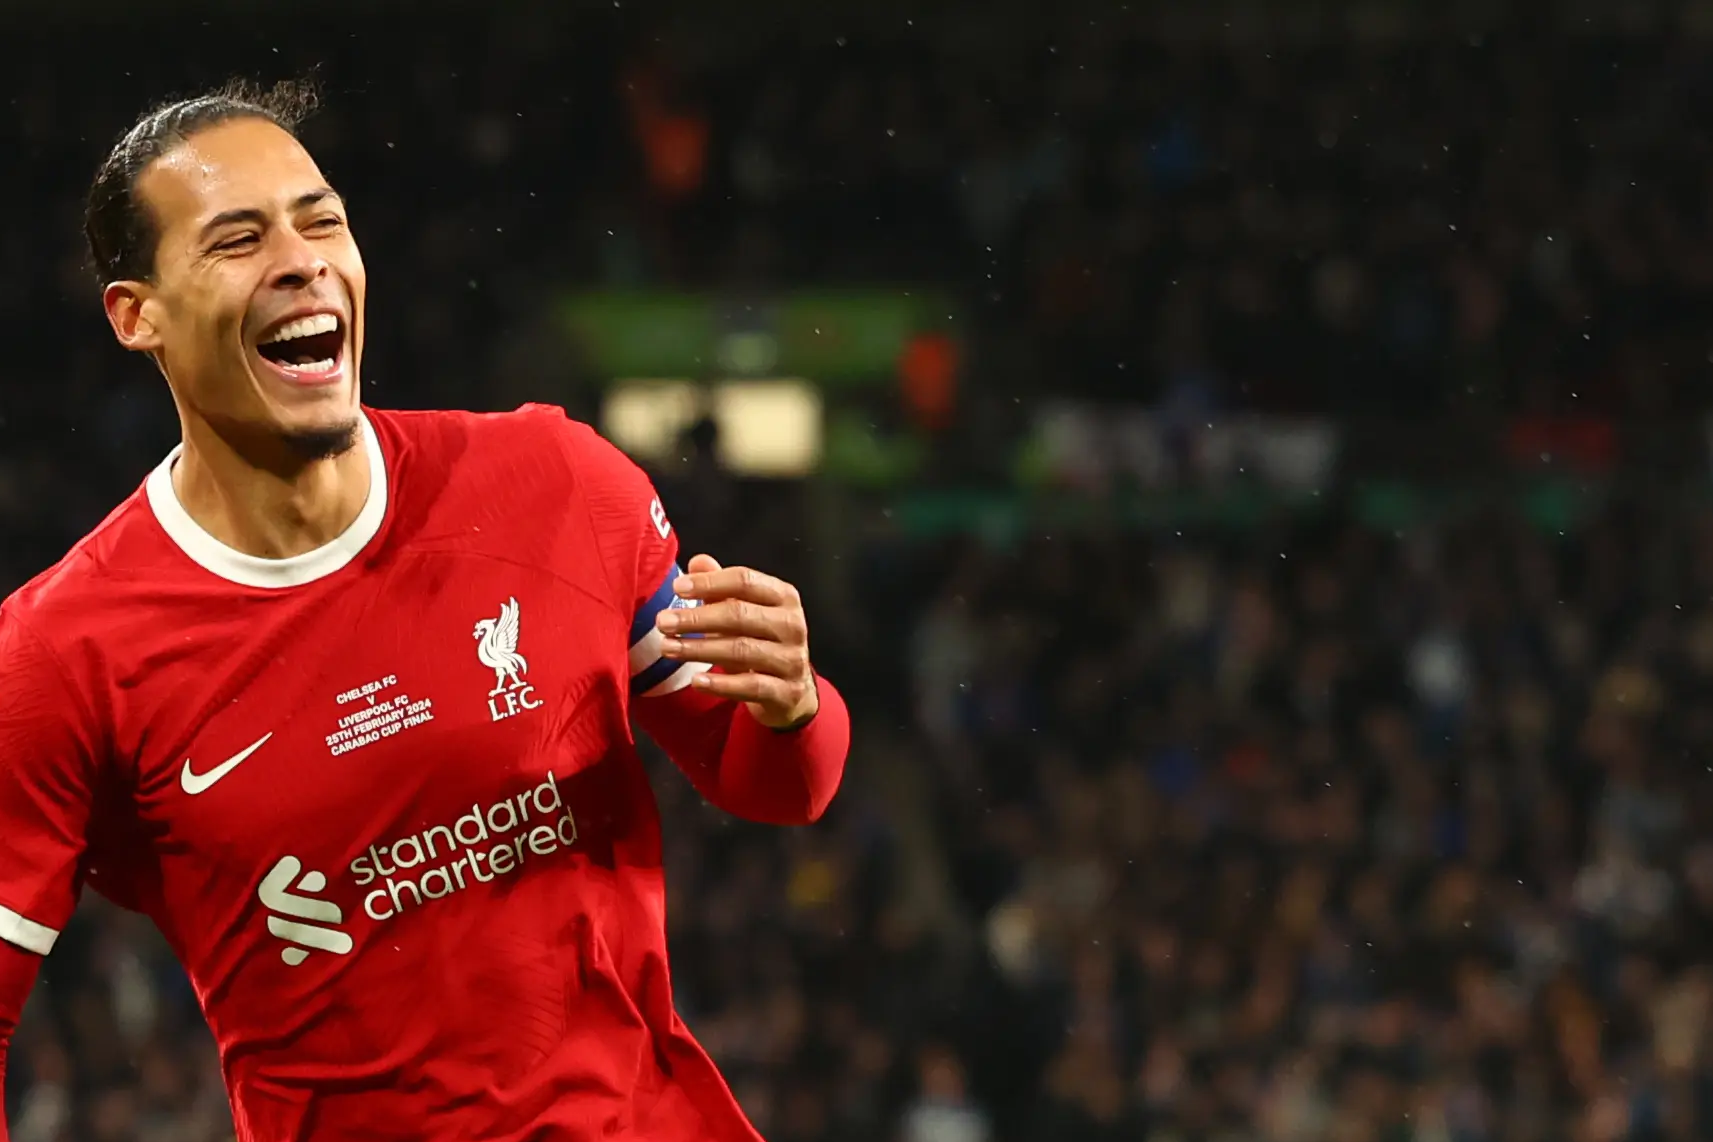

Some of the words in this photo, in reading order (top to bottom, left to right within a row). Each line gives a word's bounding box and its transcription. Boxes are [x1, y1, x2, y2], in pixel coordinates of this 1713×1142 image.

[336, 681, 383, 704] CHELSEA
[382, 674, 397, 688] FC
[338, 701, 394, 728] LIVERPOOL
[394, 694, 408, 707] FC
[325, 728, 353, 746] 25TH
[353, 708, 405, 735] FEBRUARY
[406, 698, 432, 715] 2024
[331, 731, 380, 756] CARABAO
[381, 722, 402, 737] CUP
[403, 711, 434, 729] FINAL
[350, 770, 562, 885] standard
[364, 805, 578, 920] chartered
